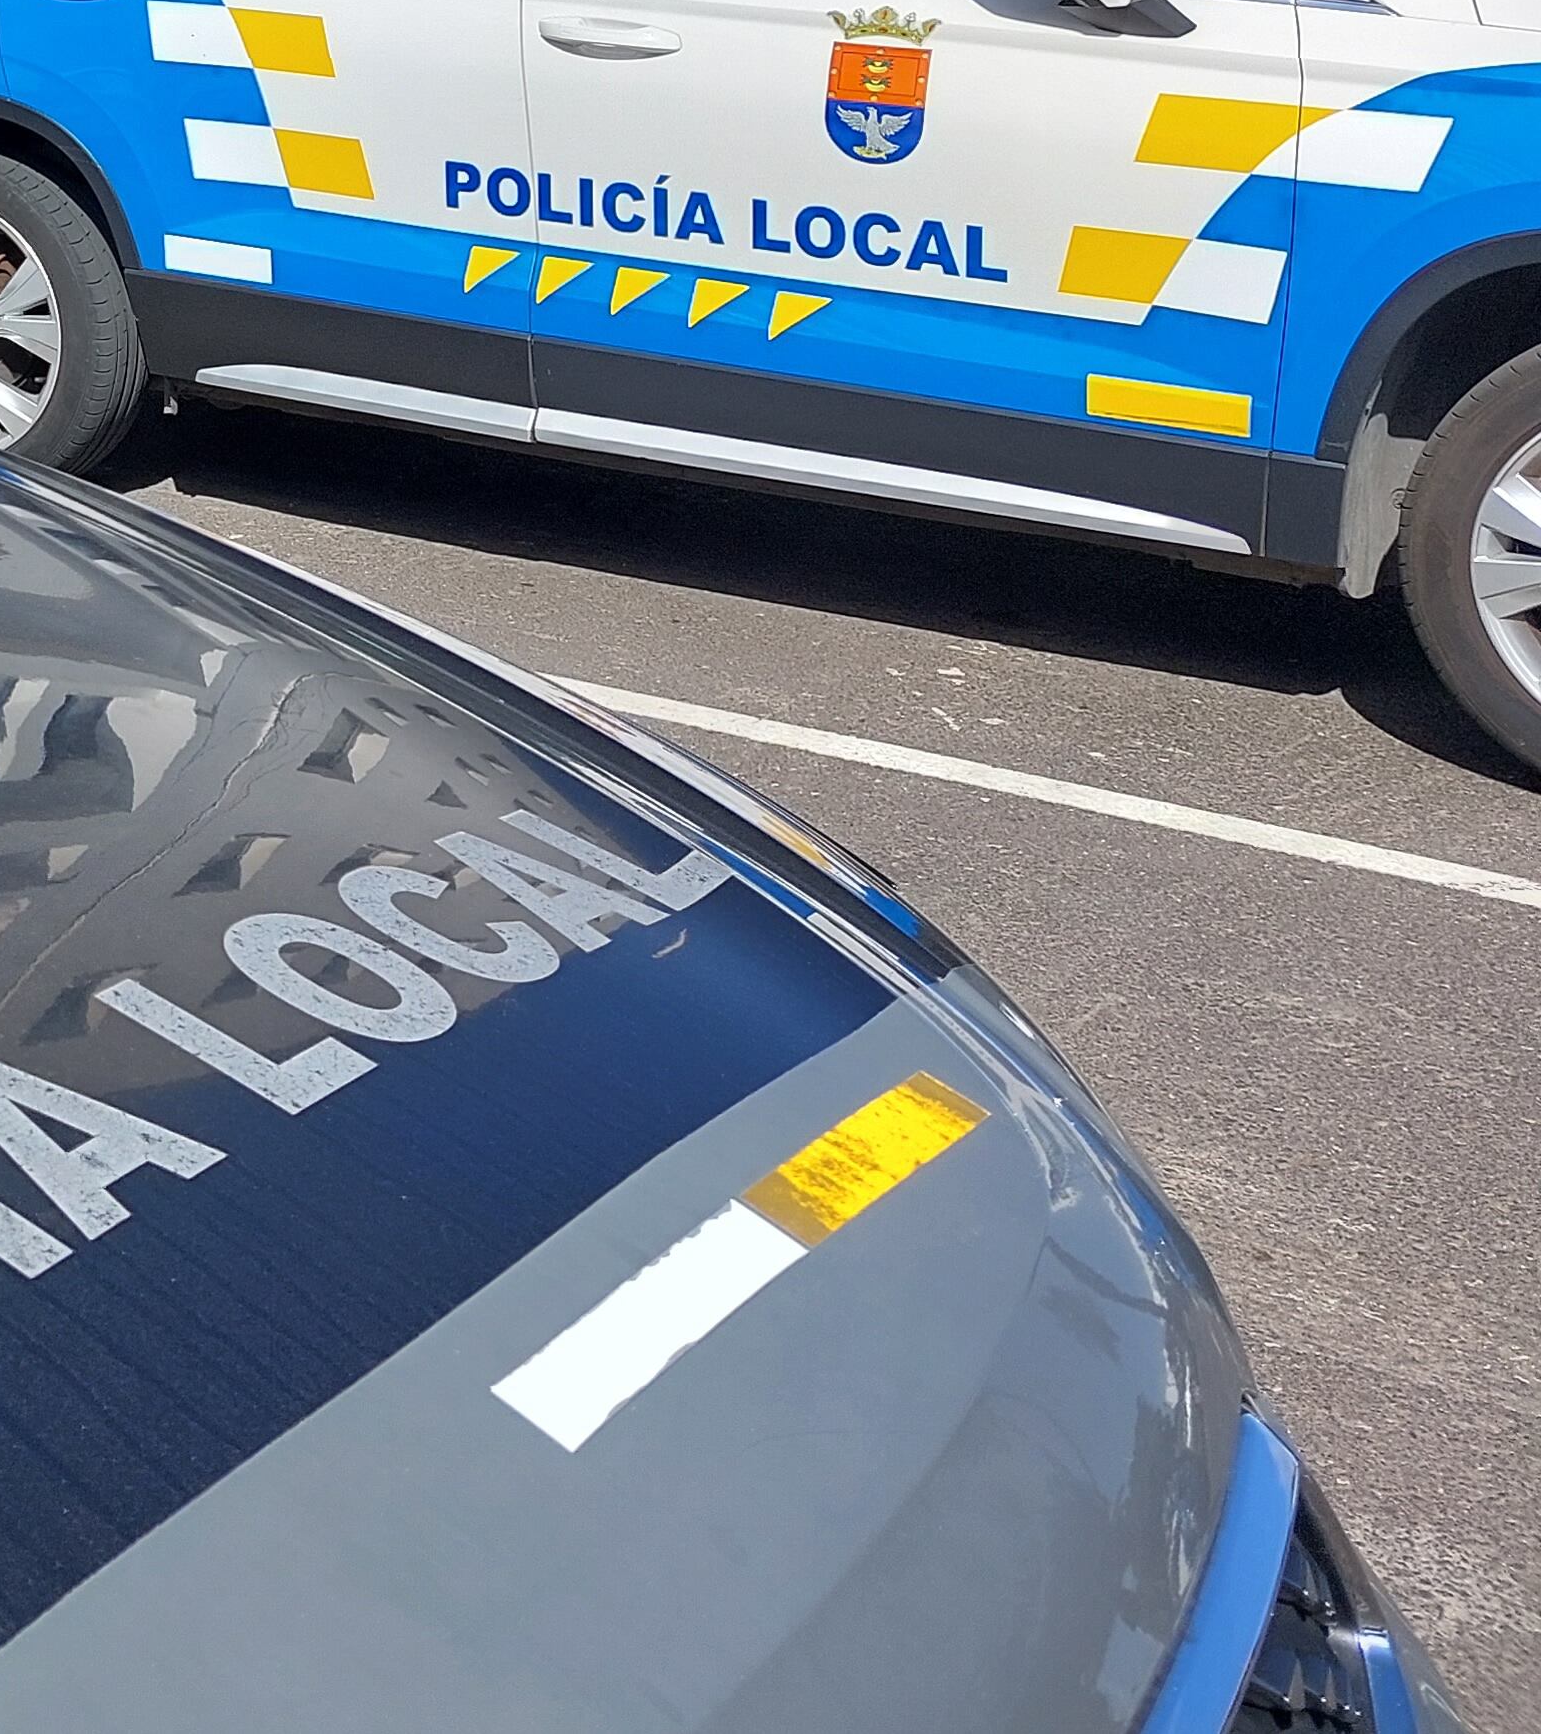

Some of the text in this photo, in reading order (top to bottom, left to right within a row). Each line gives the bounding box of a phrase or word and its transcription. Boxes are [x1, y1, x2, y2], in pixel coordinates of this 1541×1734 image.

[444, 160, 1009, 284] POLICÍA LOCAL
[95, 809, 734, 1114] LOCAL
